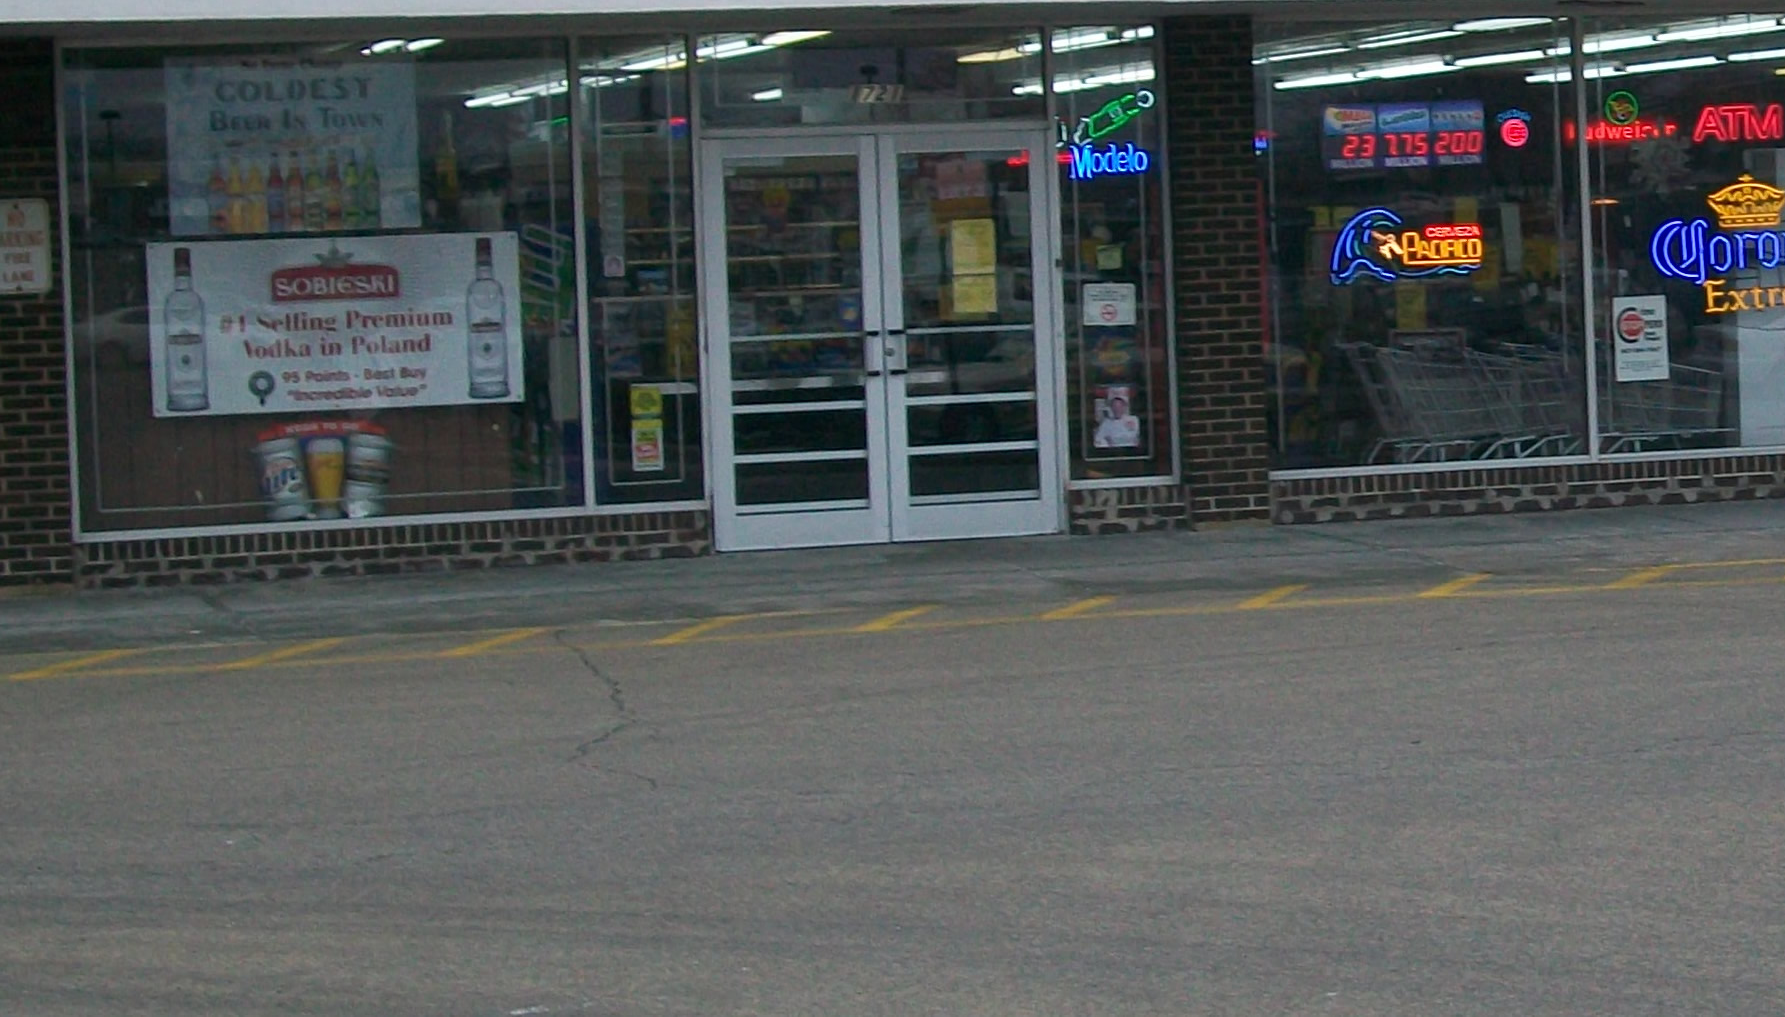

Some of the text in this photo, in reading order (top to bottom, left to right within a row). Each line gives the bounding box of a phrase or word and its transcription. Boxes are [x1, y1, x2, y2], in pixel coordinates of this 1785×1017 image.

[1694, 103, 1785, 142] ATM
[1341, 134, 1377, 159] 23
[1433, 131, 1483, 155] 200
[1068, 143, 1149, 180] Modelo
[1402, 231, 1483, 259] PACIFICO
[273, 273, 395, 297] SOBIESKI
[255, 309, 338, 332] Selling
[345, 307, 454, 330] Premium
[243, 333, 432, 360] Vodka in Poland
